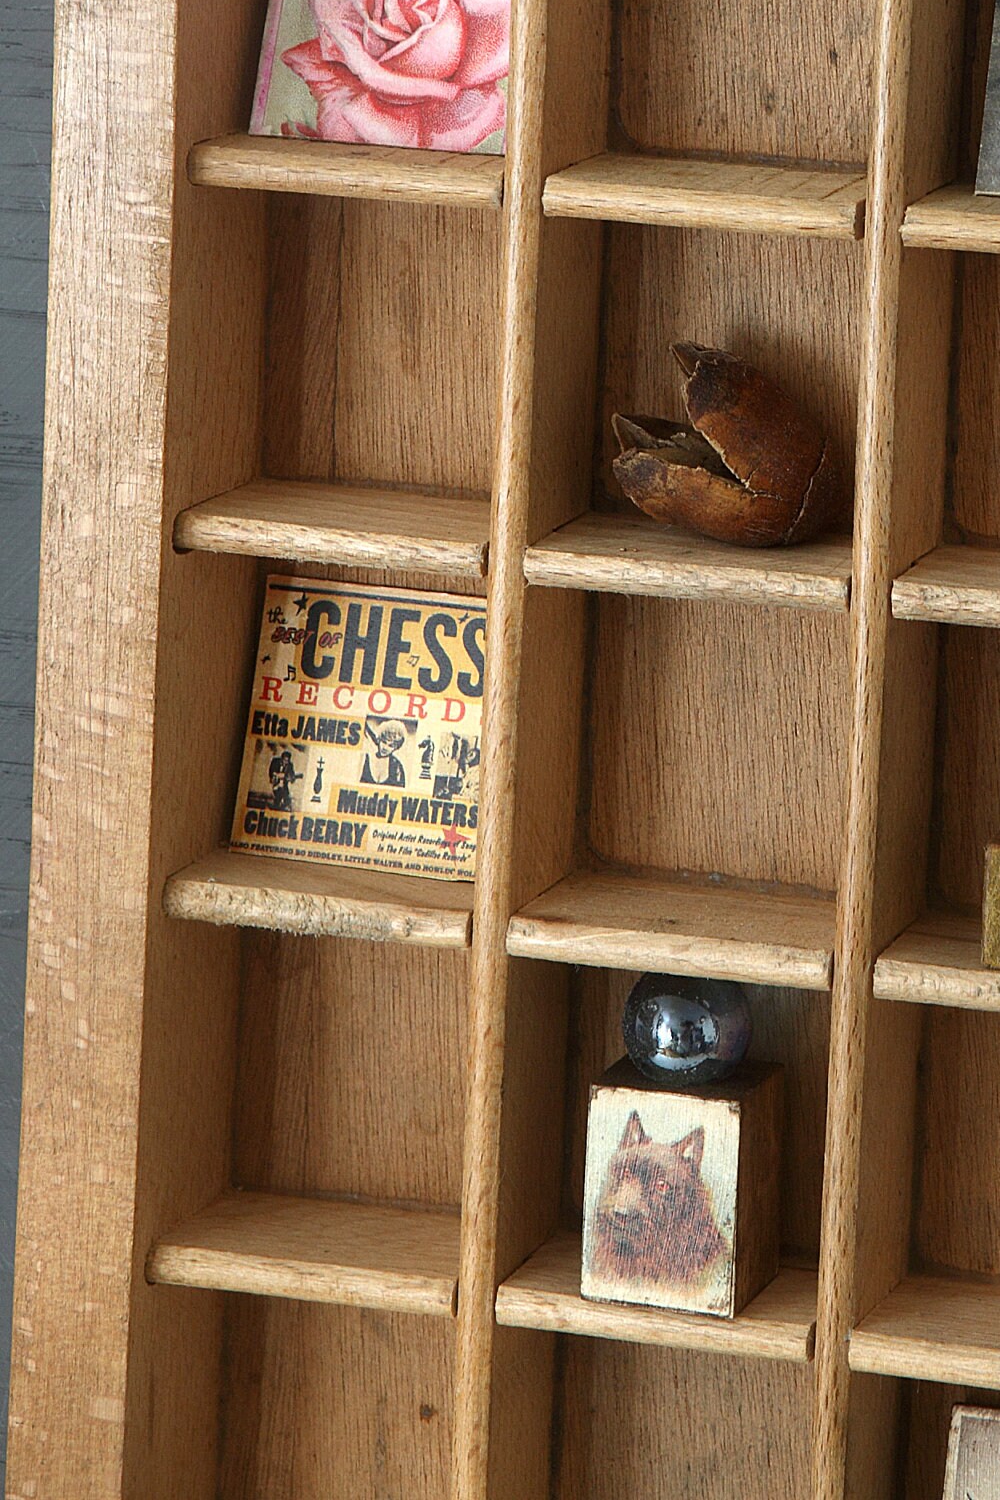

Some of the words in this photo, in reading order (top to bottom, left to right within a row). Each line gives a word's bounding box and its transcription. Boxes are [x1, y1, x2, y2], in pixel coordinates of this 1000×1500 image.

[266, 606, 288, 624] the
[271, 626, 315, 646] BEST
[318, 631, 343, 648] OF
[300, 600, 486, 698] CHESS
[259, 675, 483, 726] RECORD
[251, 710, 288, 738] Etta
[290, 715, 362, 746] JAMES
[336, 788, 399, 823] Muddy
[401, 796, 478, 829] WATERS
[243, 810, 299, 840] Chuck
[300, 816, 368, 847] BERRY
[250, 843, 293, 855] FEATURING
[295, 848, 306, 856] BO
[404, 862, 422, 871] AND
[457, 868, 476, 878] WOL
[460, 841, 477, 853] Song
